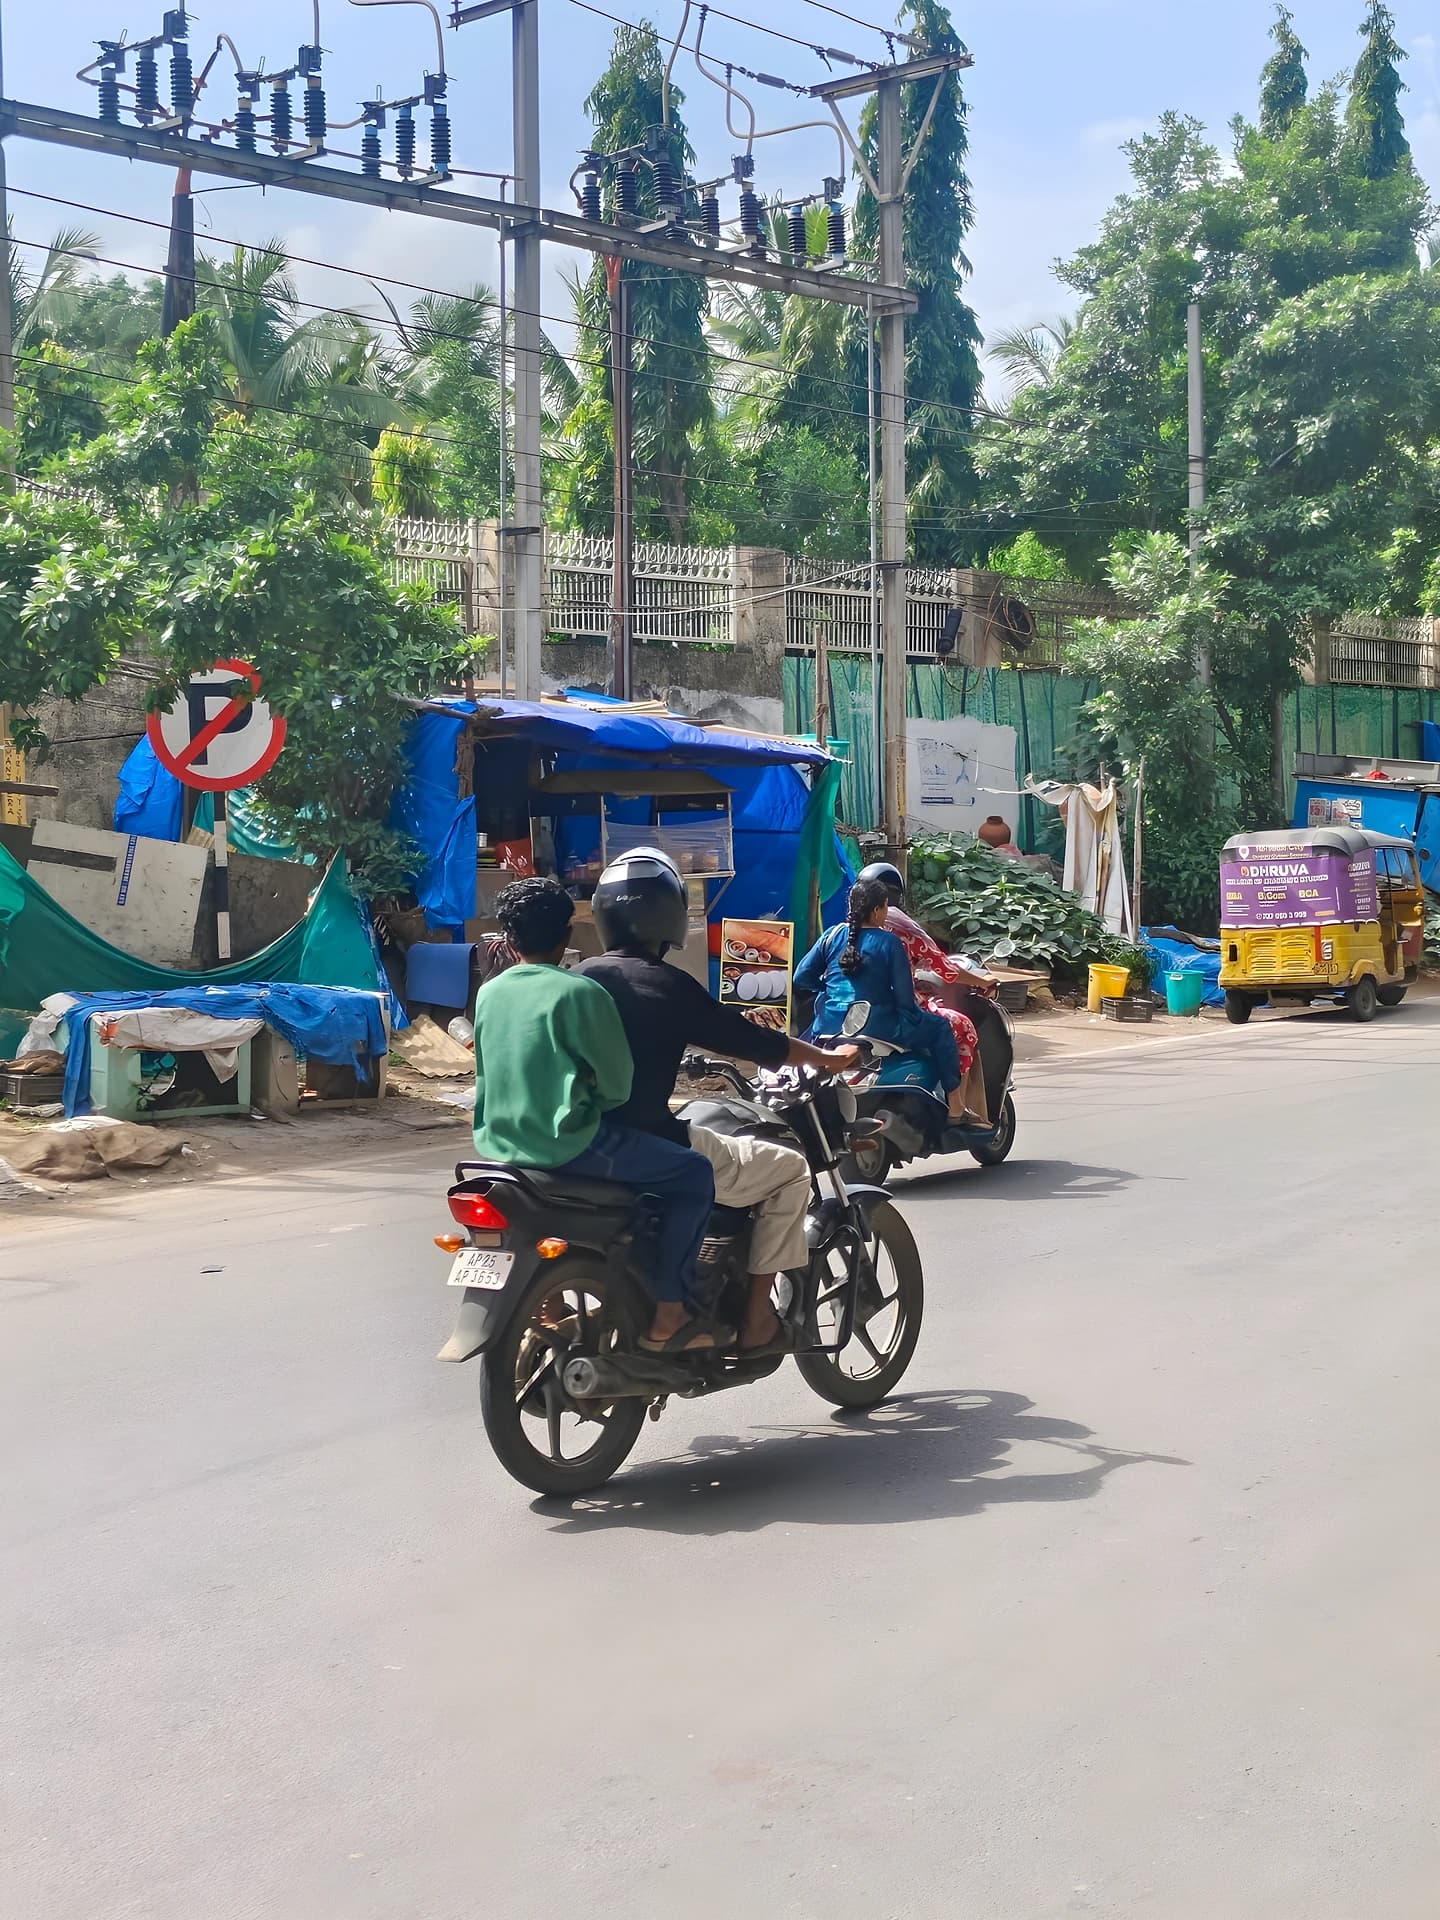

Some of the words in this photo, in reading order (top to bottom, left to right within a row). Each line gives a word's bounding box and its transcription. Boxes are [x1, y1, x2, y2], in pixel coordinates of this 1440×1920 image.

[189, 682, 252, 765] P
[1249, 863, 1309, 877] DHRUVA
[467, 1252, 497, 1268] AP25
